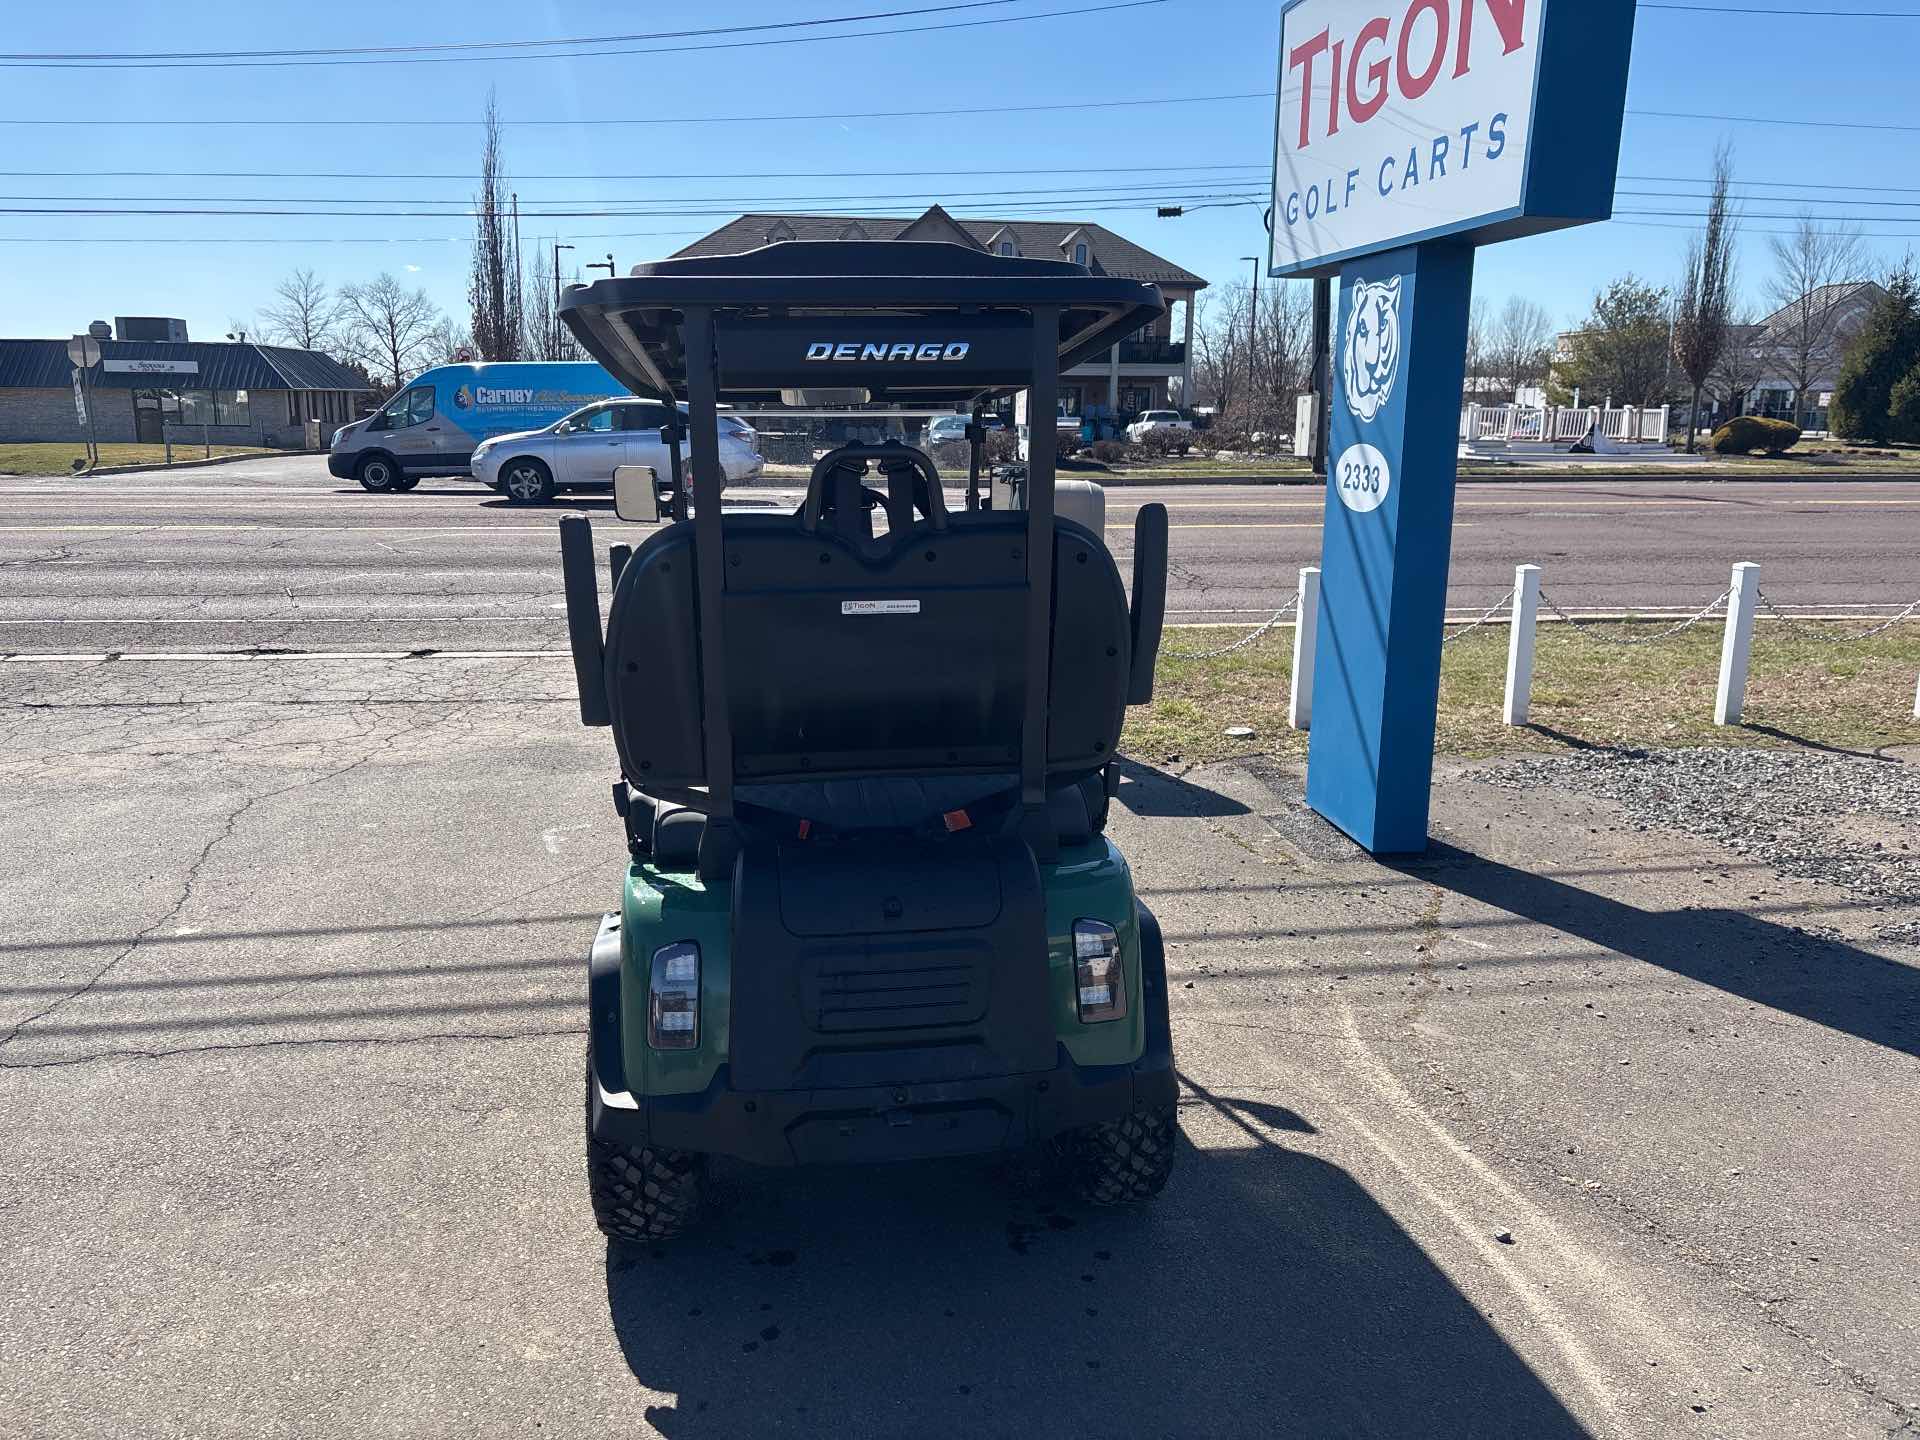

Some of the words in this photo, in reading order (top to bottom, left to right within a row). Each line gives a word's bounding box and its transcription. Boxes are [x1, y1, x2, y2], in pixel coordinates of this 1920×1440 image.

[1289, 0, 1525, 150] TIGON
[1286, 168, 1360, 226] GOLF
[1377, 112, 1509, 196] CARTS
[805, 342, 970, 361] DENAGO
[475, 386, 534, 404] Carney
[1343, 462, 1381, 494] 2333
